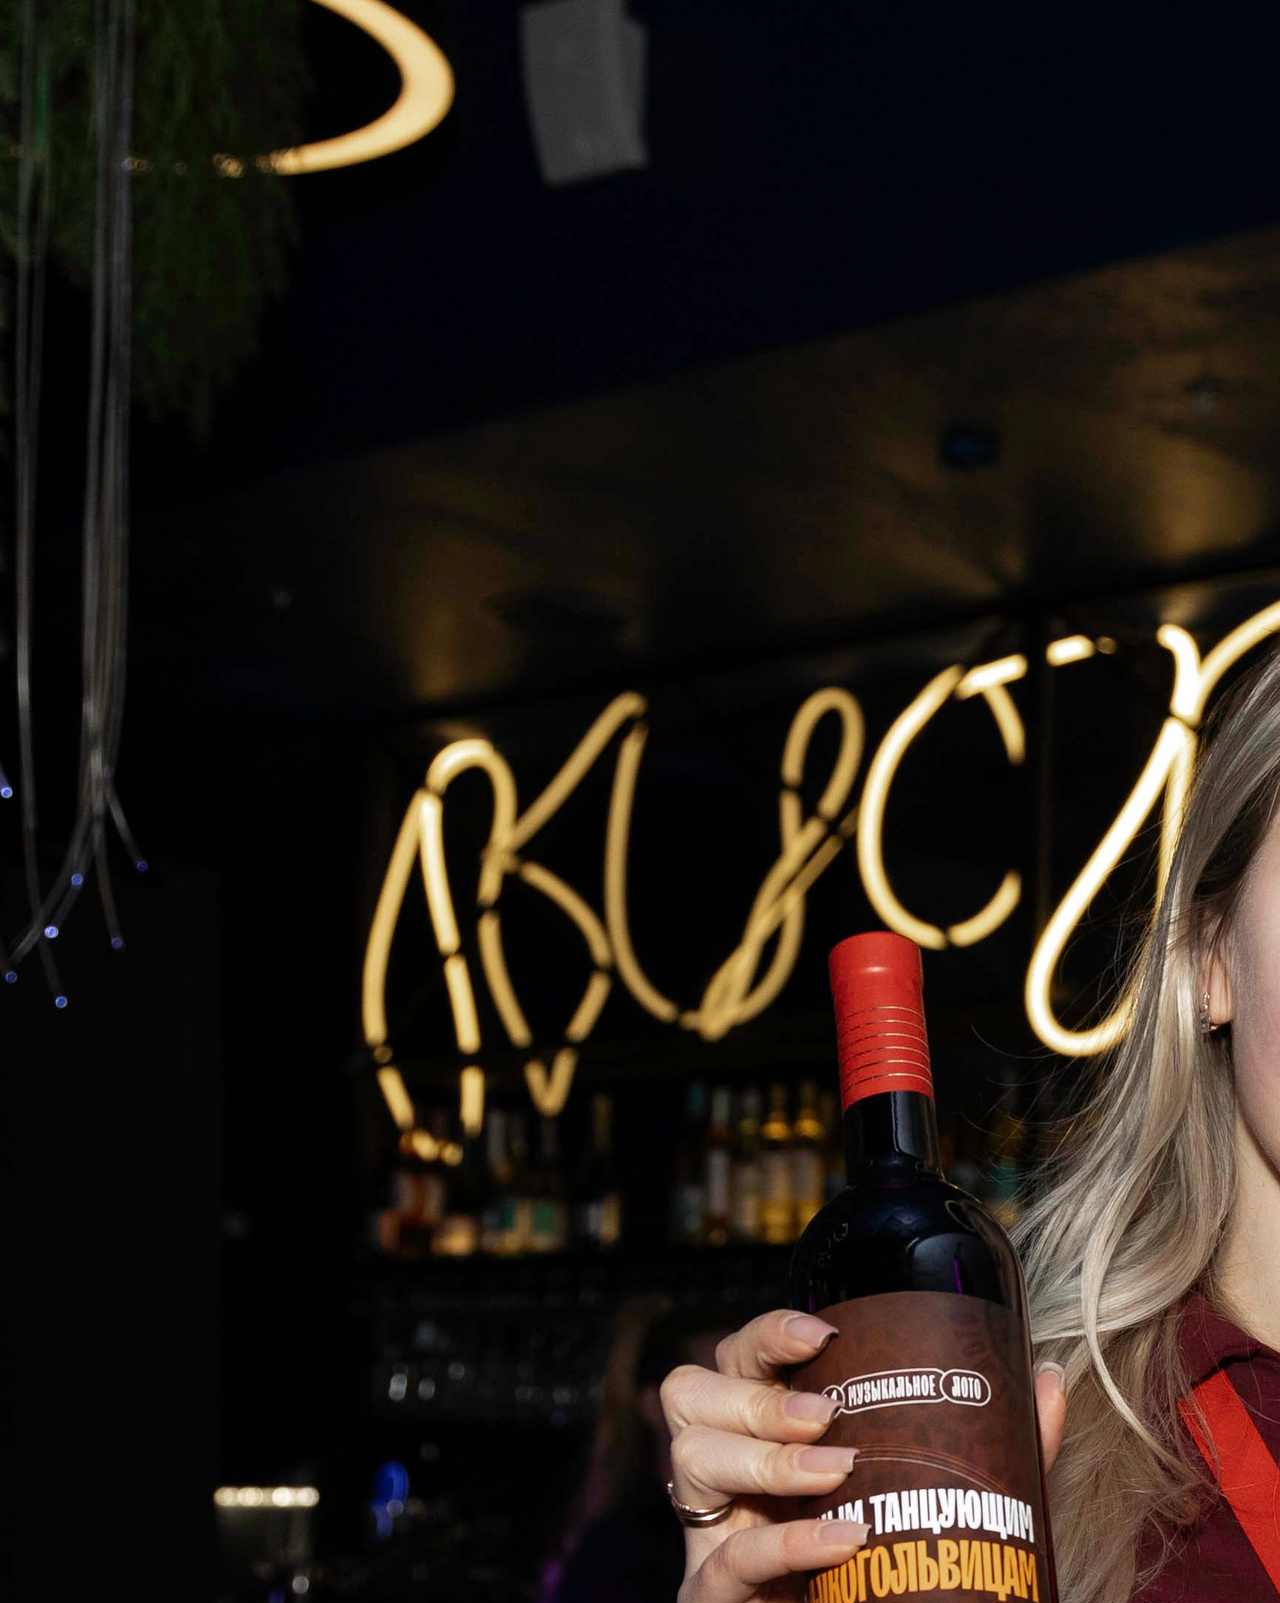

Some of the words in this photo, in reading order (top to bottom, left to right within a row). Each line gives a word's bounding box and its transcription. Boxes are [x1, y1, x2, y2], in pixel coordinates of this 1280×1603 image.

[848, 1375, 936, 1407] МУЗЫКАЛЬНОЕ
[951, 1376, 982, 1401] ЛОТО
[869, 1488, 1035, 1544] ТАНЦУЮЩИМ
